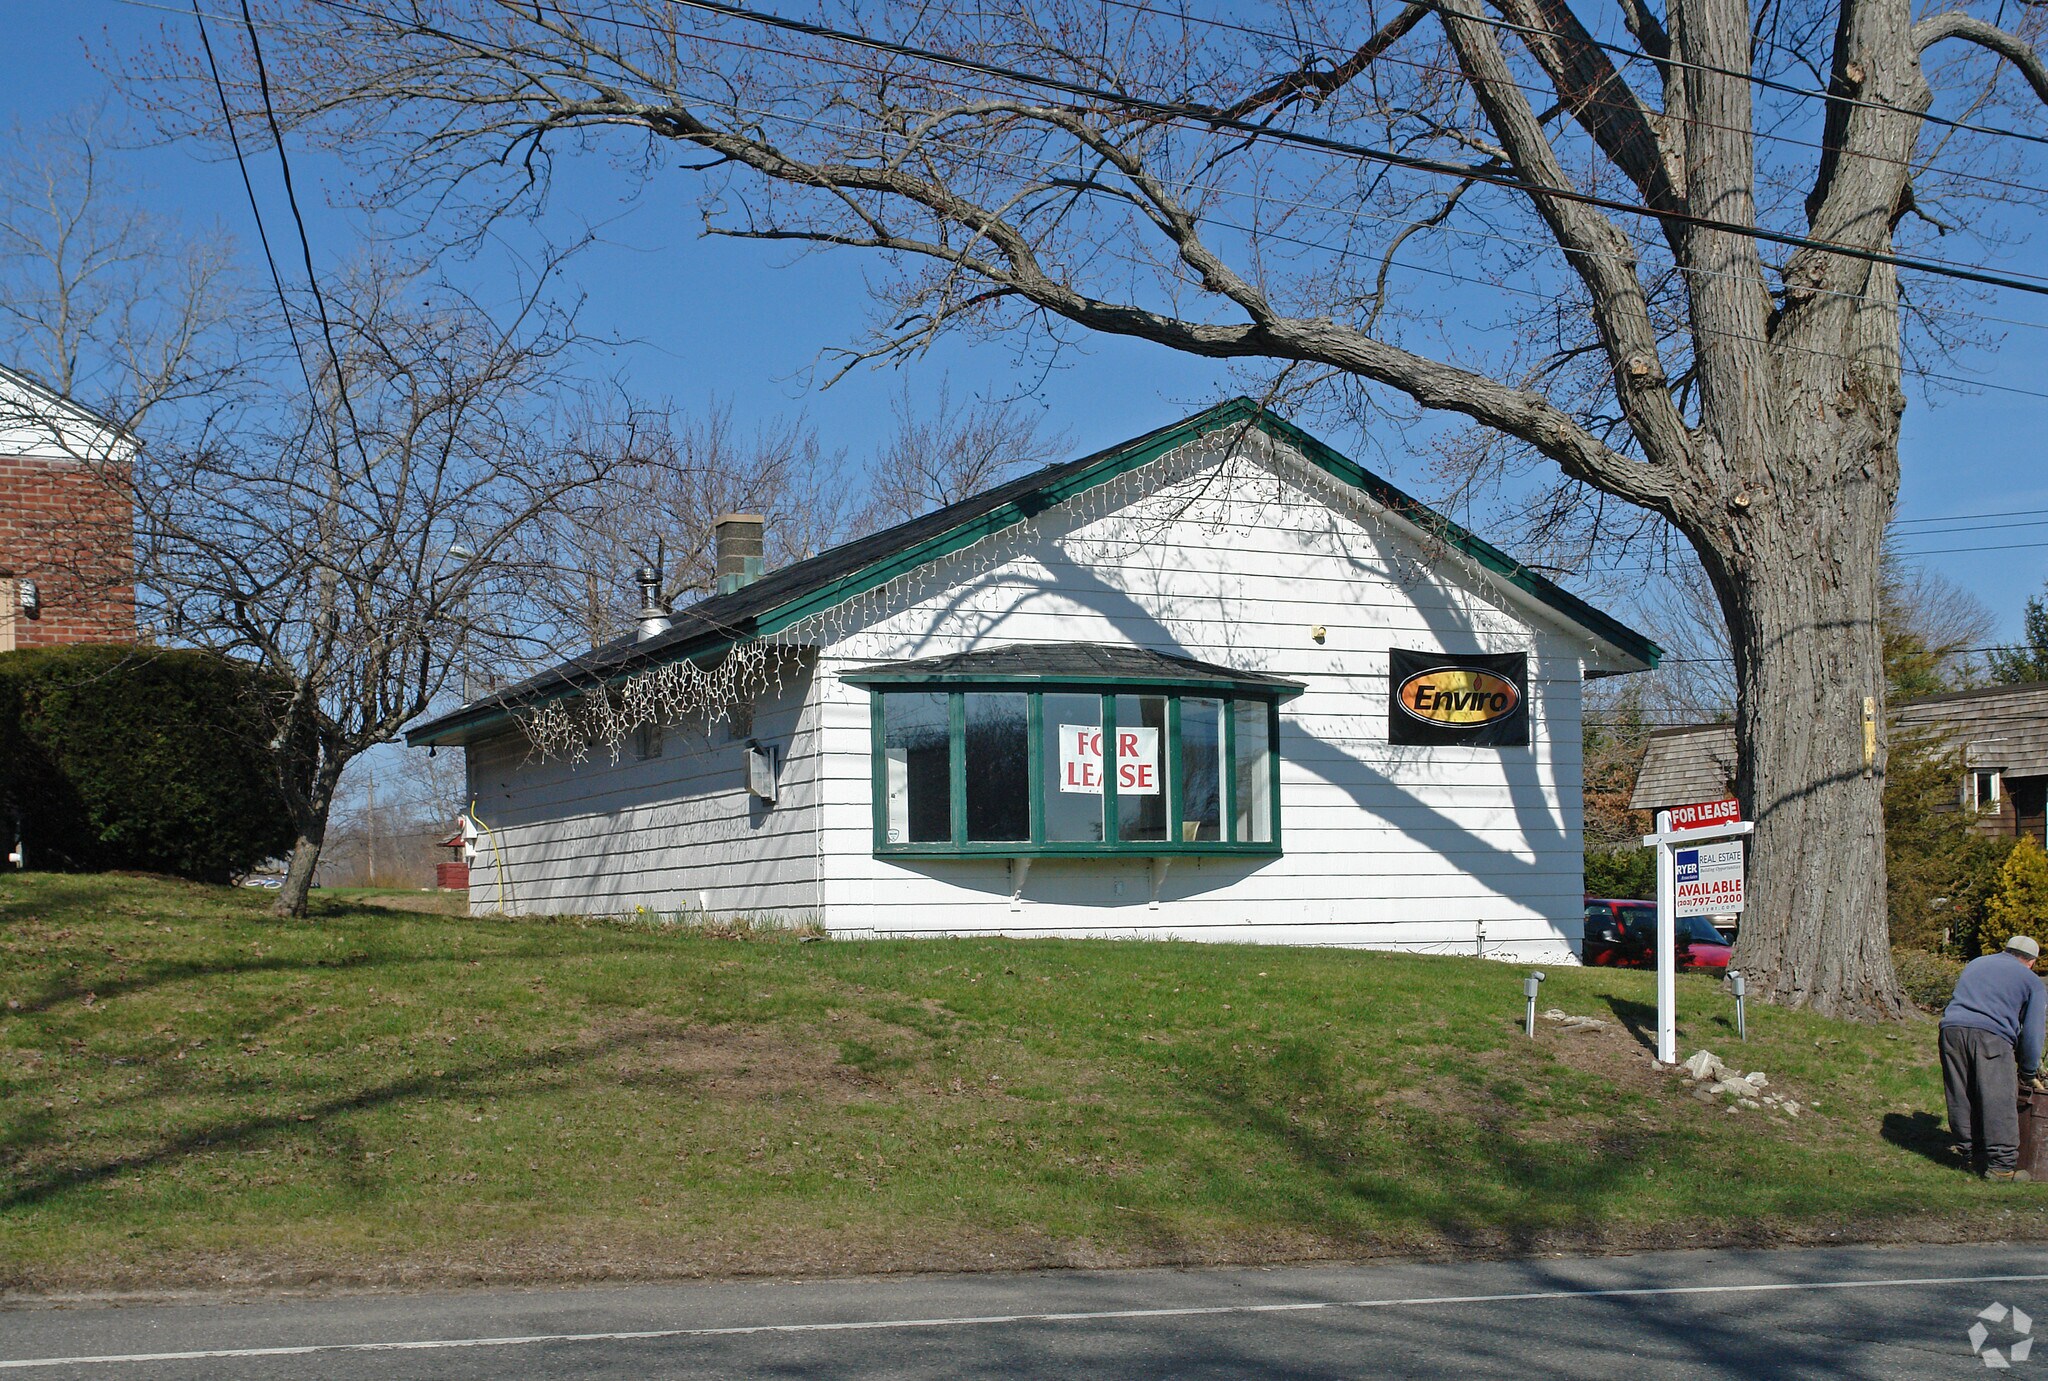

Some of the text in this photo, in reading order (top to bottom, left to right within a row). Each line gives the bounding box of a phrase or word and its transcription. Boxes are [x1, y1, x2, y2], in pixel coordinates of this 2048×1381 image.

[1414, 683, 1508, 711] Enviro
[1067, 762, 1152, 788] LESE
[1672, 801, 1738, 824] FOR LEASE
[1700, 851, 1741, 864] REAL ESTATE
[1677, 863, 1697, 875] RYER
[1678, 879, 1741, 897] AVAILABLE
